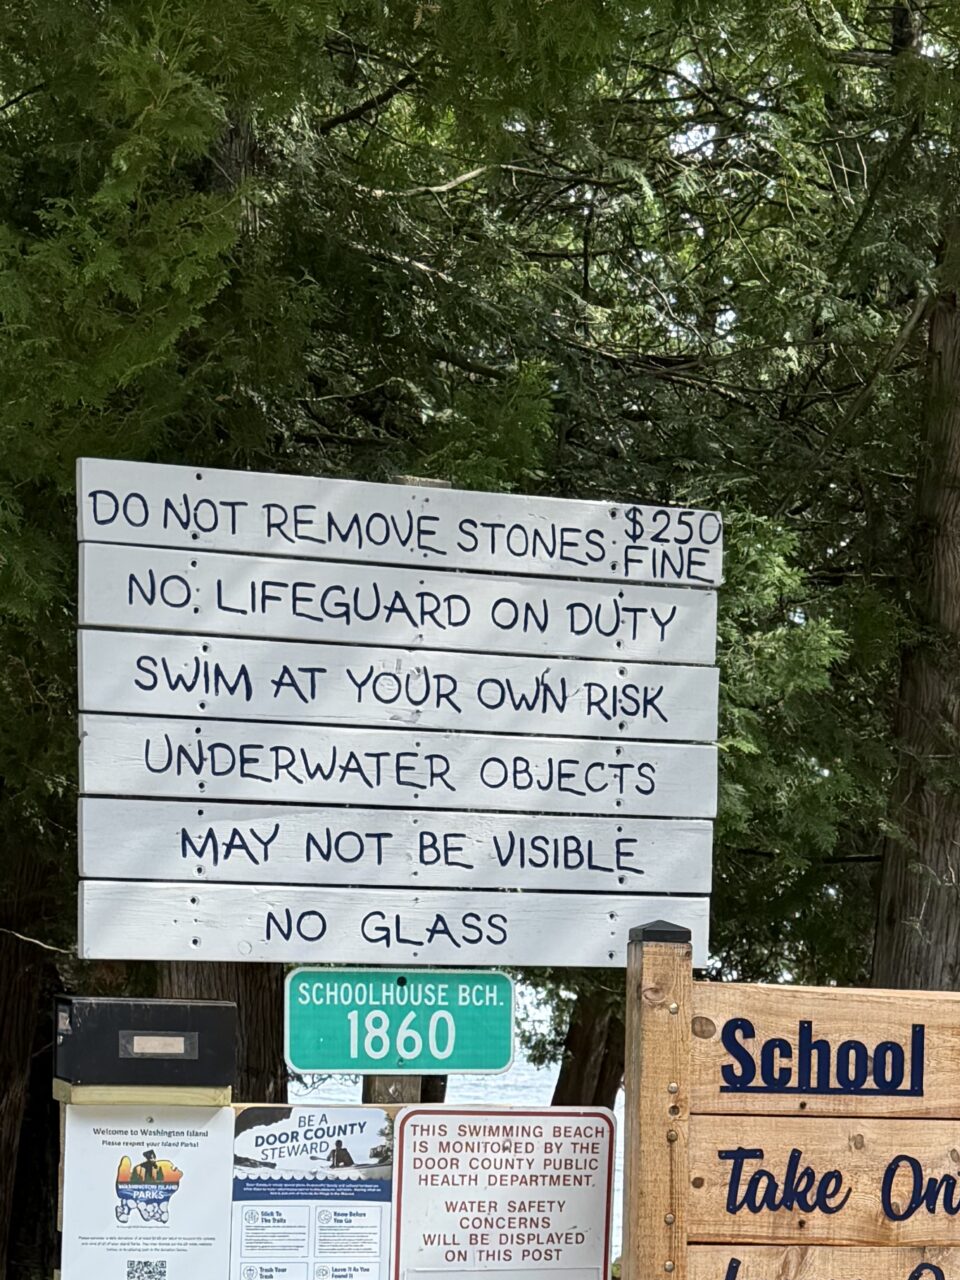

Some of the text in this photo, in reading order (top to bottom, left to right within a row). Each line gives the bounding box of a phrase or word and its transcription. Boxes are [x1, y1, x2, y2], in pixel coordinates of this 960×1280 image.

[88, 490, 149, 527] DO
[163, 494, 248, 535] NOT
[262, 503, 447, 555] REMOVE
[624, 506, 722, 545] $250
[624, 545, 714, 583] FINE
[128, 569, 677, 641] NO LIFEGUARD ON DUTY
[134, 655, 668, 723] SWIM AT YOUR OWN RISK
[144, 733, 656, 796] UNDERWATER OBJECTS
[181, 823, 644, 874] MAY NOT BE VISIBLE
[266, 908, 508, 948] NO GLASS
[298, 982, 504, 1006] SCHOOLHOUSE BCH.
[347, 1010, 455, 1060] 1860
[720, 1018, 925, 1096] School
[93, 1128, 129, 1136] Welcome
[140, 1129, 185, 1137] Washington
[298, 1113, 328, 1128] BE A
[410, 1124, 604, 1138] THIS SWIMMING BEACH
[254, 1121, 367, 1147] DOOR COUNTY
[261, 1141, 330, 1161] STEWARD
[413, 1141, 600, 1154] IS MONITORED BY THE
[413, 1157, 599, 1171] DOOR COUNTY PUBLIC
[418, 1174, 478, 1187] HEALTH
[718, 1147, 853, 1215] Take
[133, 1190, 164, 1199] PARKS
[445, 1200, 566, 1213] WATER SAFETY
[459, 1217, 551, 1229] CONCERNS
[423, 1232, 585, 1246] WILL BE DISPLAYED
[445, 1249, 562, 1262] ON THIS POST
